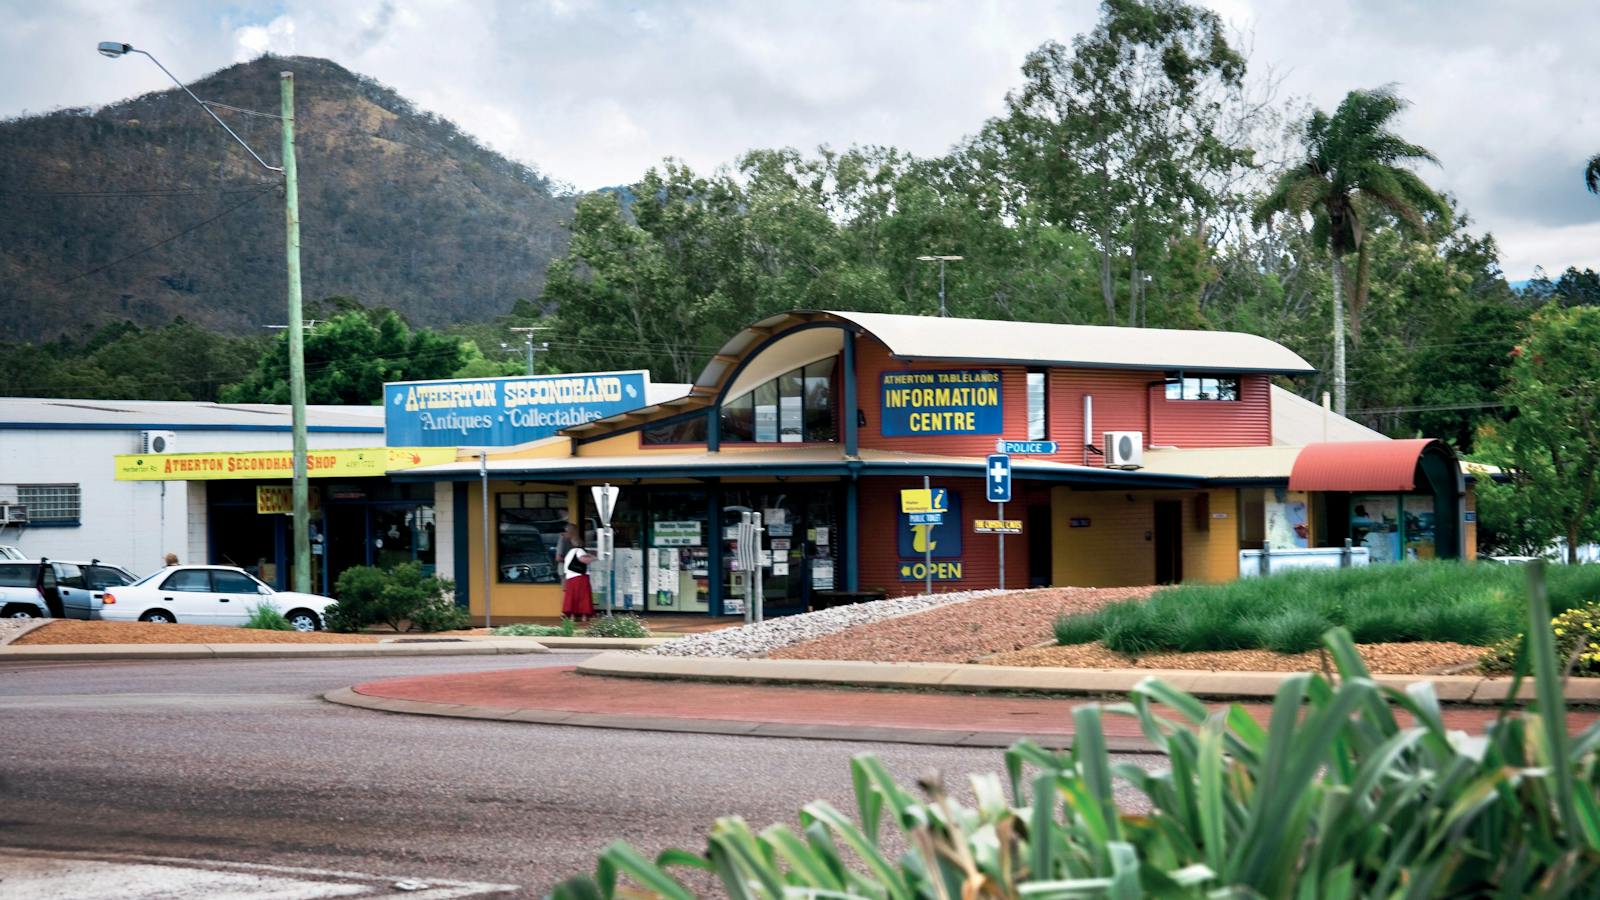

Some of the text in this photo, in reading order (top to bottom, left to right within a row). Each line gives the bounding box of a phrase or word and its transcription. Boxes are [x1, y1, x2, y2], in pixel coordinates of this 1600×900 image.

[884, 373, 999, 385] ATHERTON TABLELANDS
[405, 377, 622, 411] ATHERTON SECONDHAND
[886, 387, 999, 408] INFORMATION
[420, 407, 603, 436] Antiques Collectables
[909, 412, 976, 432] CENTRE
[1006, 442, 1043, 453] POLICE
[164, 458, 223, 474] ATHERTON
[228, 457, 294, 472] SECONDHAN
[306, 455, 337, 470] SHOP
[912, 562, 963, 580] OPEN
